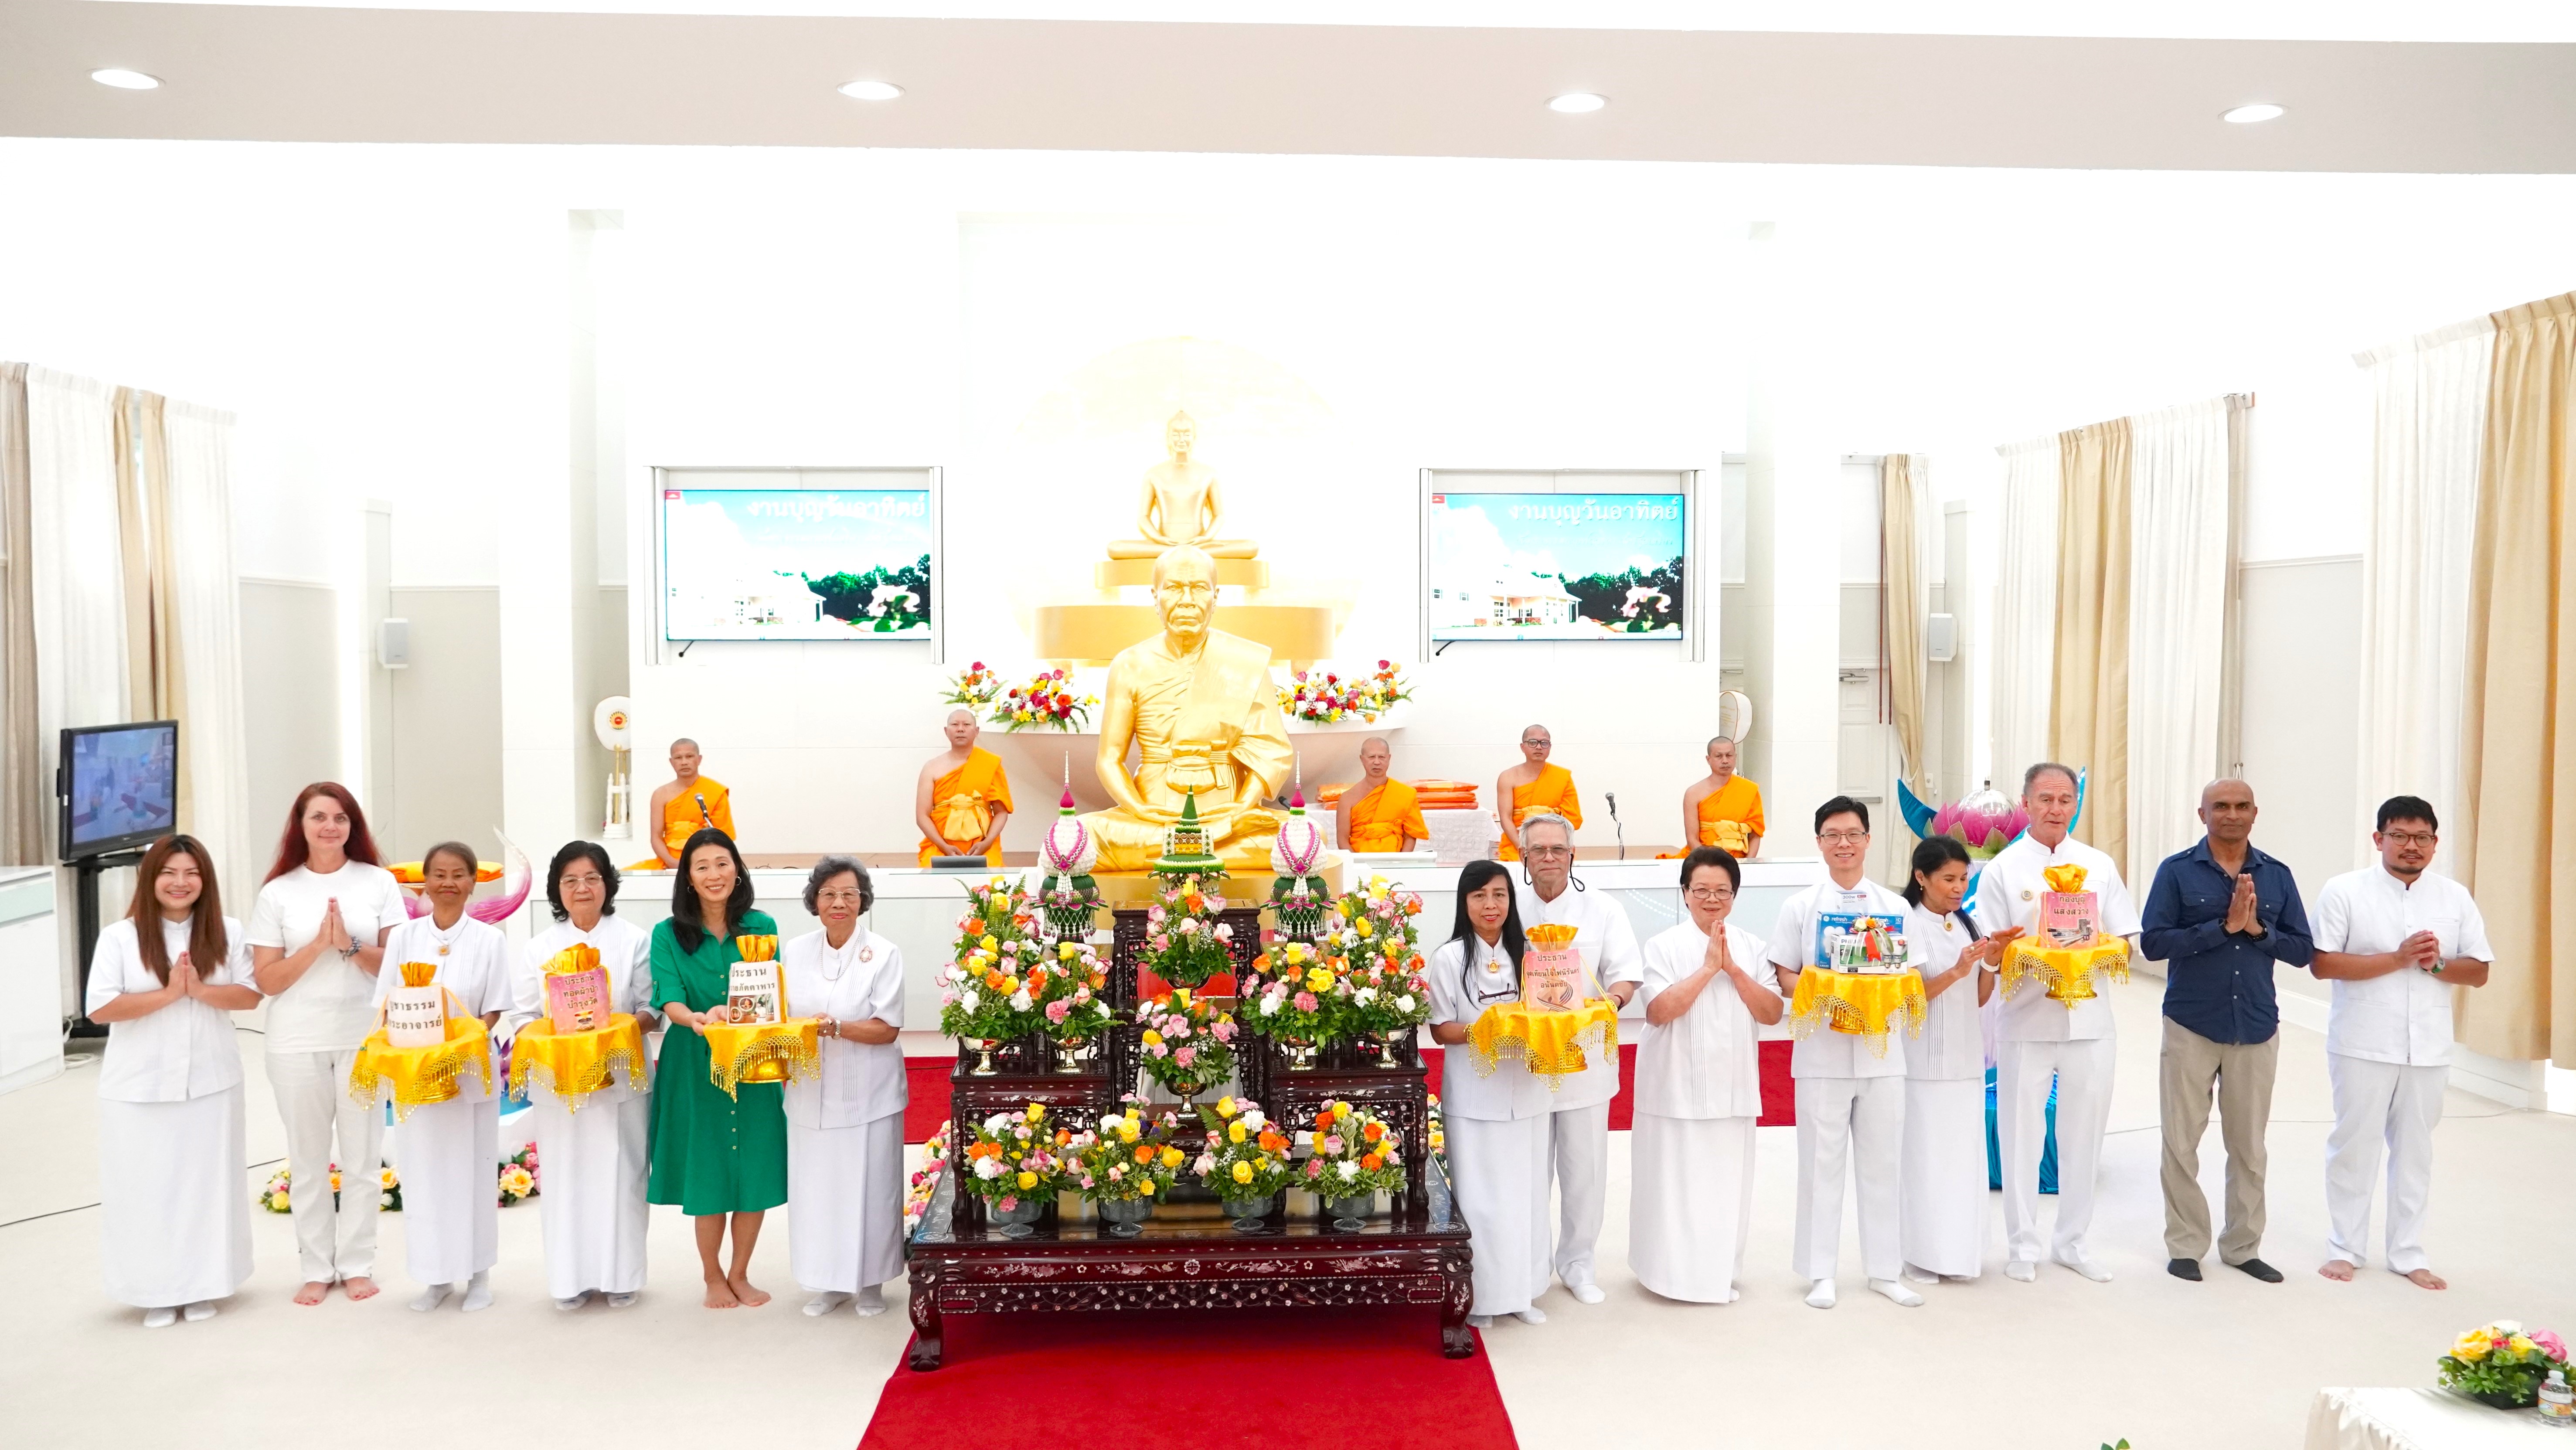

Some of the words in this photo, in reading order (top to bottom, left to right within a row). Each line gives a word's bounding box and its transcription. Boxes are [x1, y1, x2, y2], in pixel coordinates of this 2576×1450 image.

[747, 494, 925, 522] งานบุญวันอาทิตย์
[1510, 496, 1679, 527] งานบุญวันอาทิตย์
[2059, 896, 2086, 905] กองบุญ
[732, 966, 767, 977] ประธาน
[565, 976, 594, 985] ประธาน
[1541, 980, 1568, 988] อนันตชัย
[563, 985, 599, 997] ทอดผ้าป่า
[729, 983, 775, 991] วายภัตตาหาร
[567, 997, 598, 1010] บำรุงวัด
